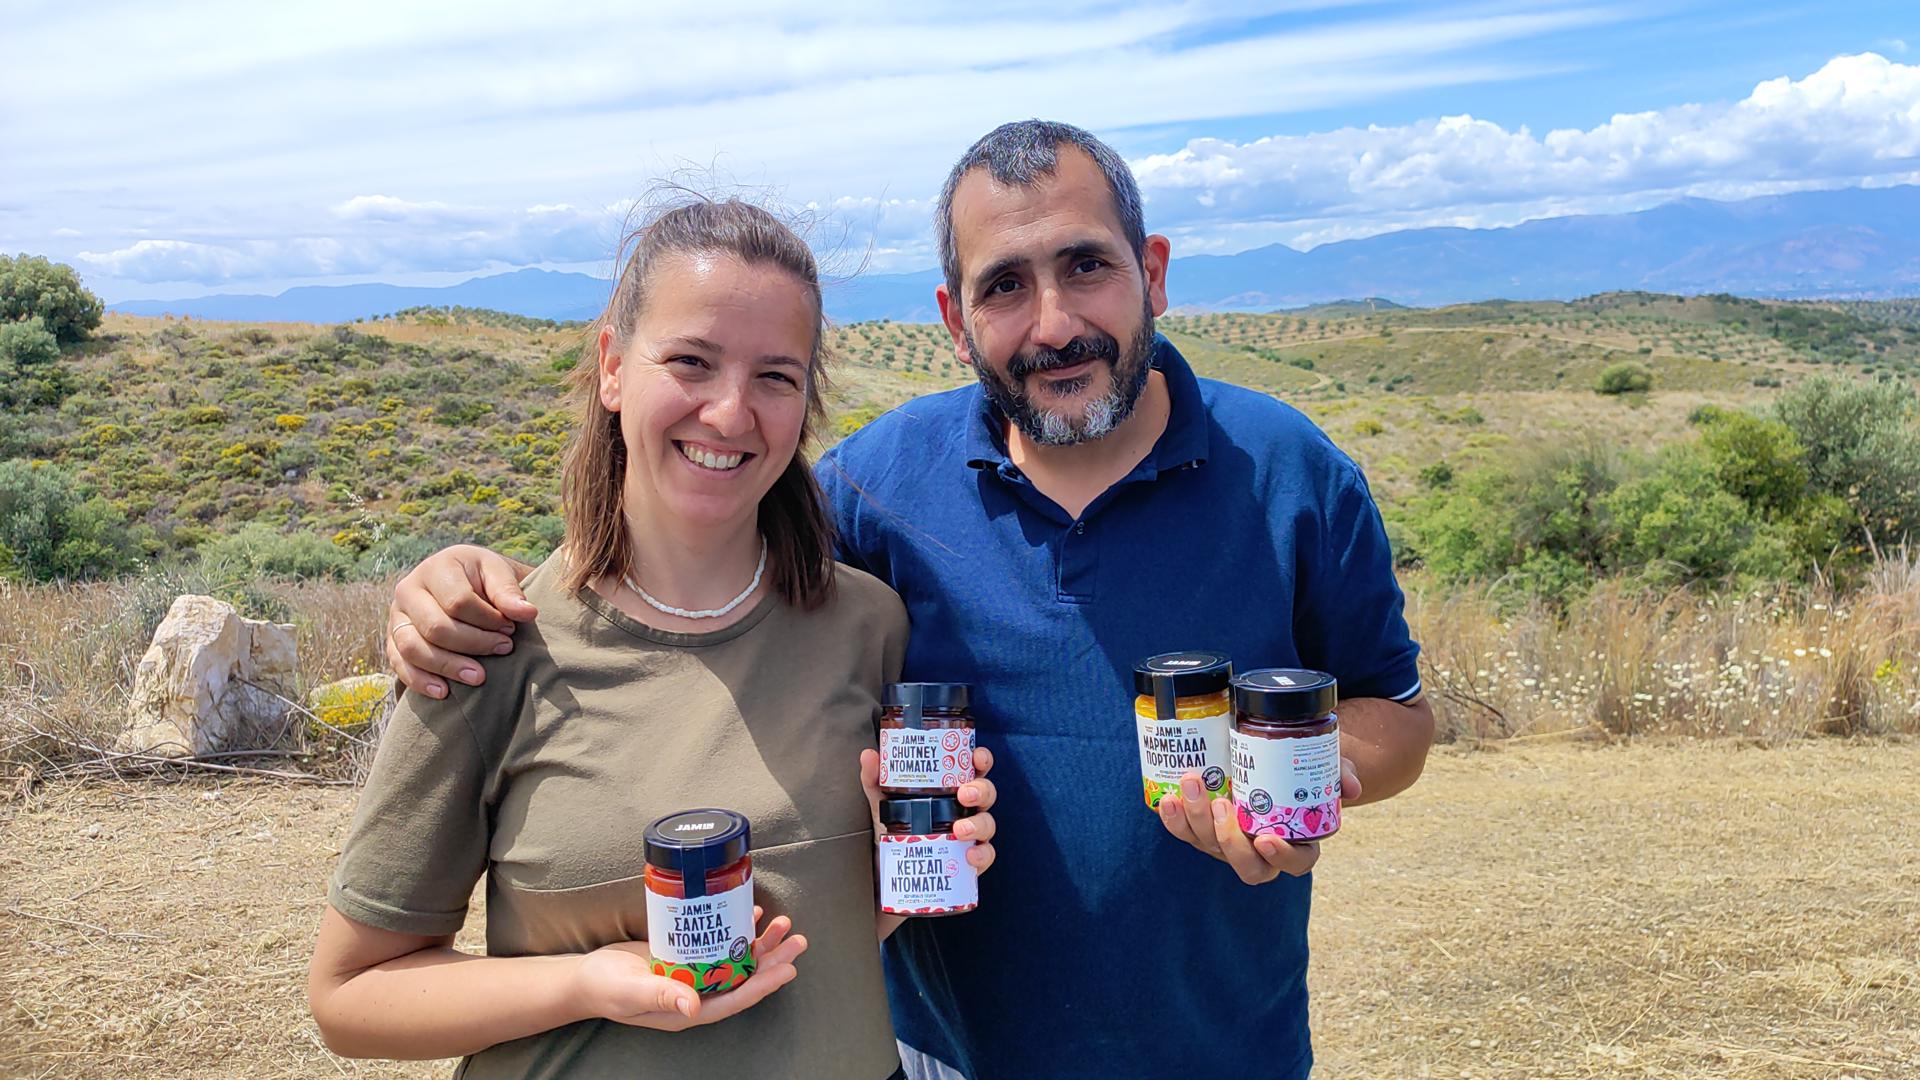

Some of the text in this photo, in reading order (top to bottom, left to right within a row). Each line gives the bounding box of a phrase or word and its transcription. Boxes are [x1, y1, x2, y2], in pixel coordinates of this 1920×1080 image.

[1155, 726, 1182, 737] JAMIN
[901, 735, 925, 744] JAMIN
[892, 746, 937, 759] CHUTNEY
[1146, 751, 1206, 768] ΠΟΡΤΟΚΑΛΙ
[889, 760, 940, 772] ΝΤΟΜΑΤΑΣ
[674, 822, 715, 831] JAMIN
[904, 846, 933, 858] JAMIN
[897, 859, 943, 876] ΚΕΤΣΑΠ
[891, 876, 952, 893] ΝΤΟΜΑΤΑΣ
[681, 903, 712, 915] JAMIN
[674, 913, 723, 931] ΣΑΛΤΣΑ
[668, 926, 732, 947] ΝΤΟΜΑΤΑΣ
